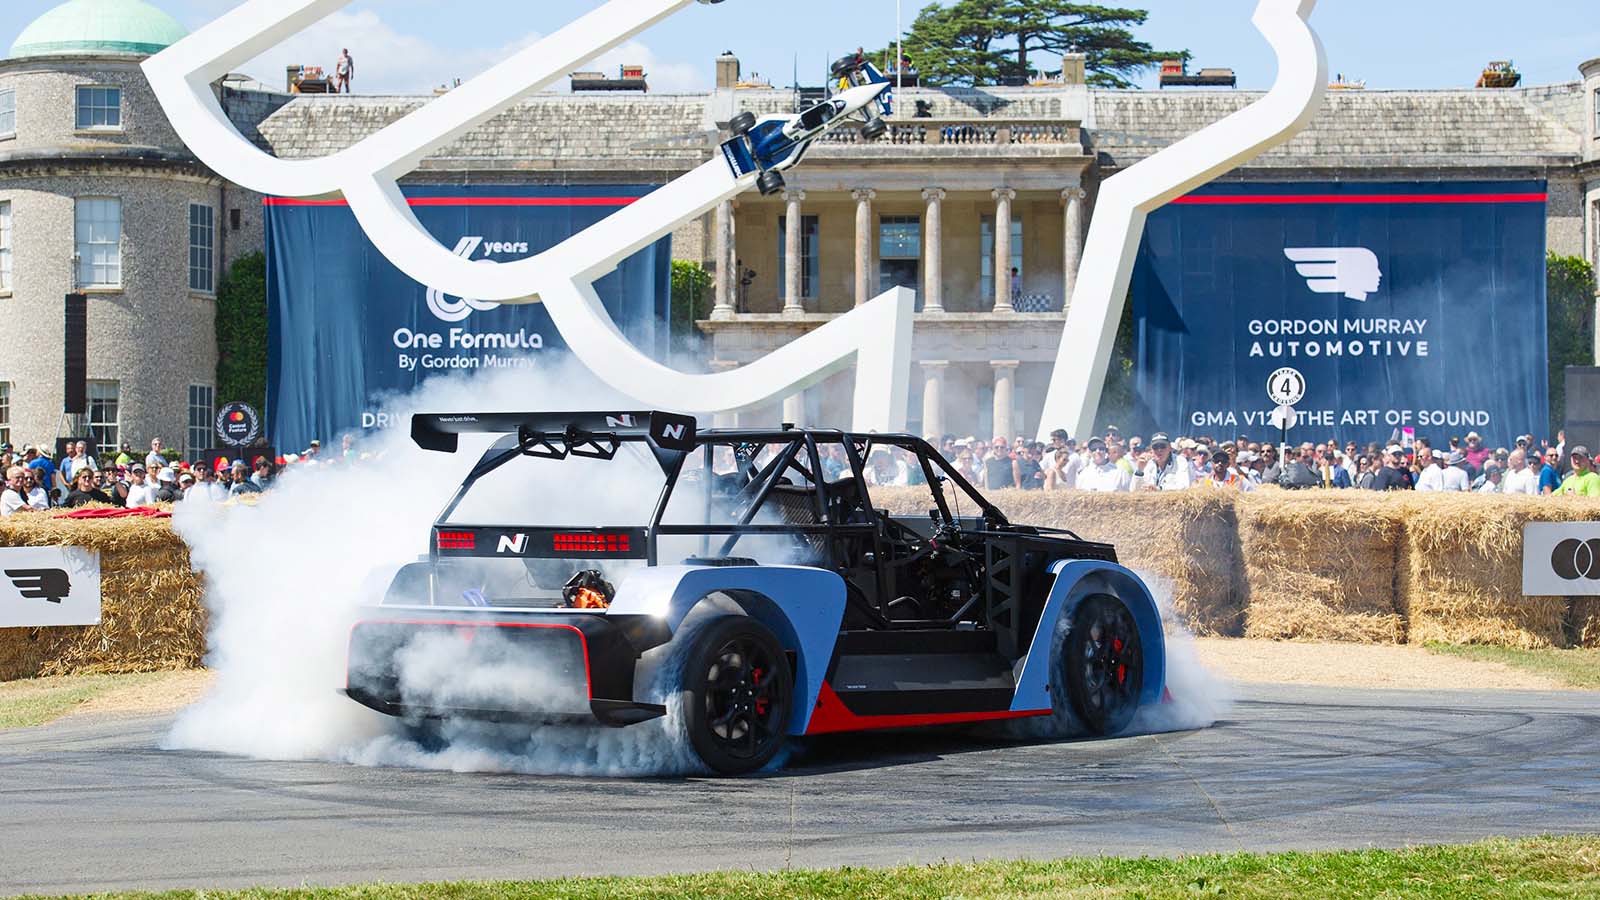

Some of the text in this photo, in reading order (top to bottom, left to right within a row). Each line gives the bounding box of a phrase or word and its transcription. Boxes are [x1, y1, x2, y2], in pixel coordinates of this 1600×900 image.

[484, 241, 528, 256] years
[1248, 318, 1427, 335] GORDON MURRAY
[393, 327, 543, 349] One Formula
[1249, 340, 1429, 357] AUTOMOTIVE
[399, 354, 537, 371] By Gordon Murray
[1280, 378, 1292, 396] 4
[1191, 410, 1490, 426] GMA V12 THE ART OF SOUND
